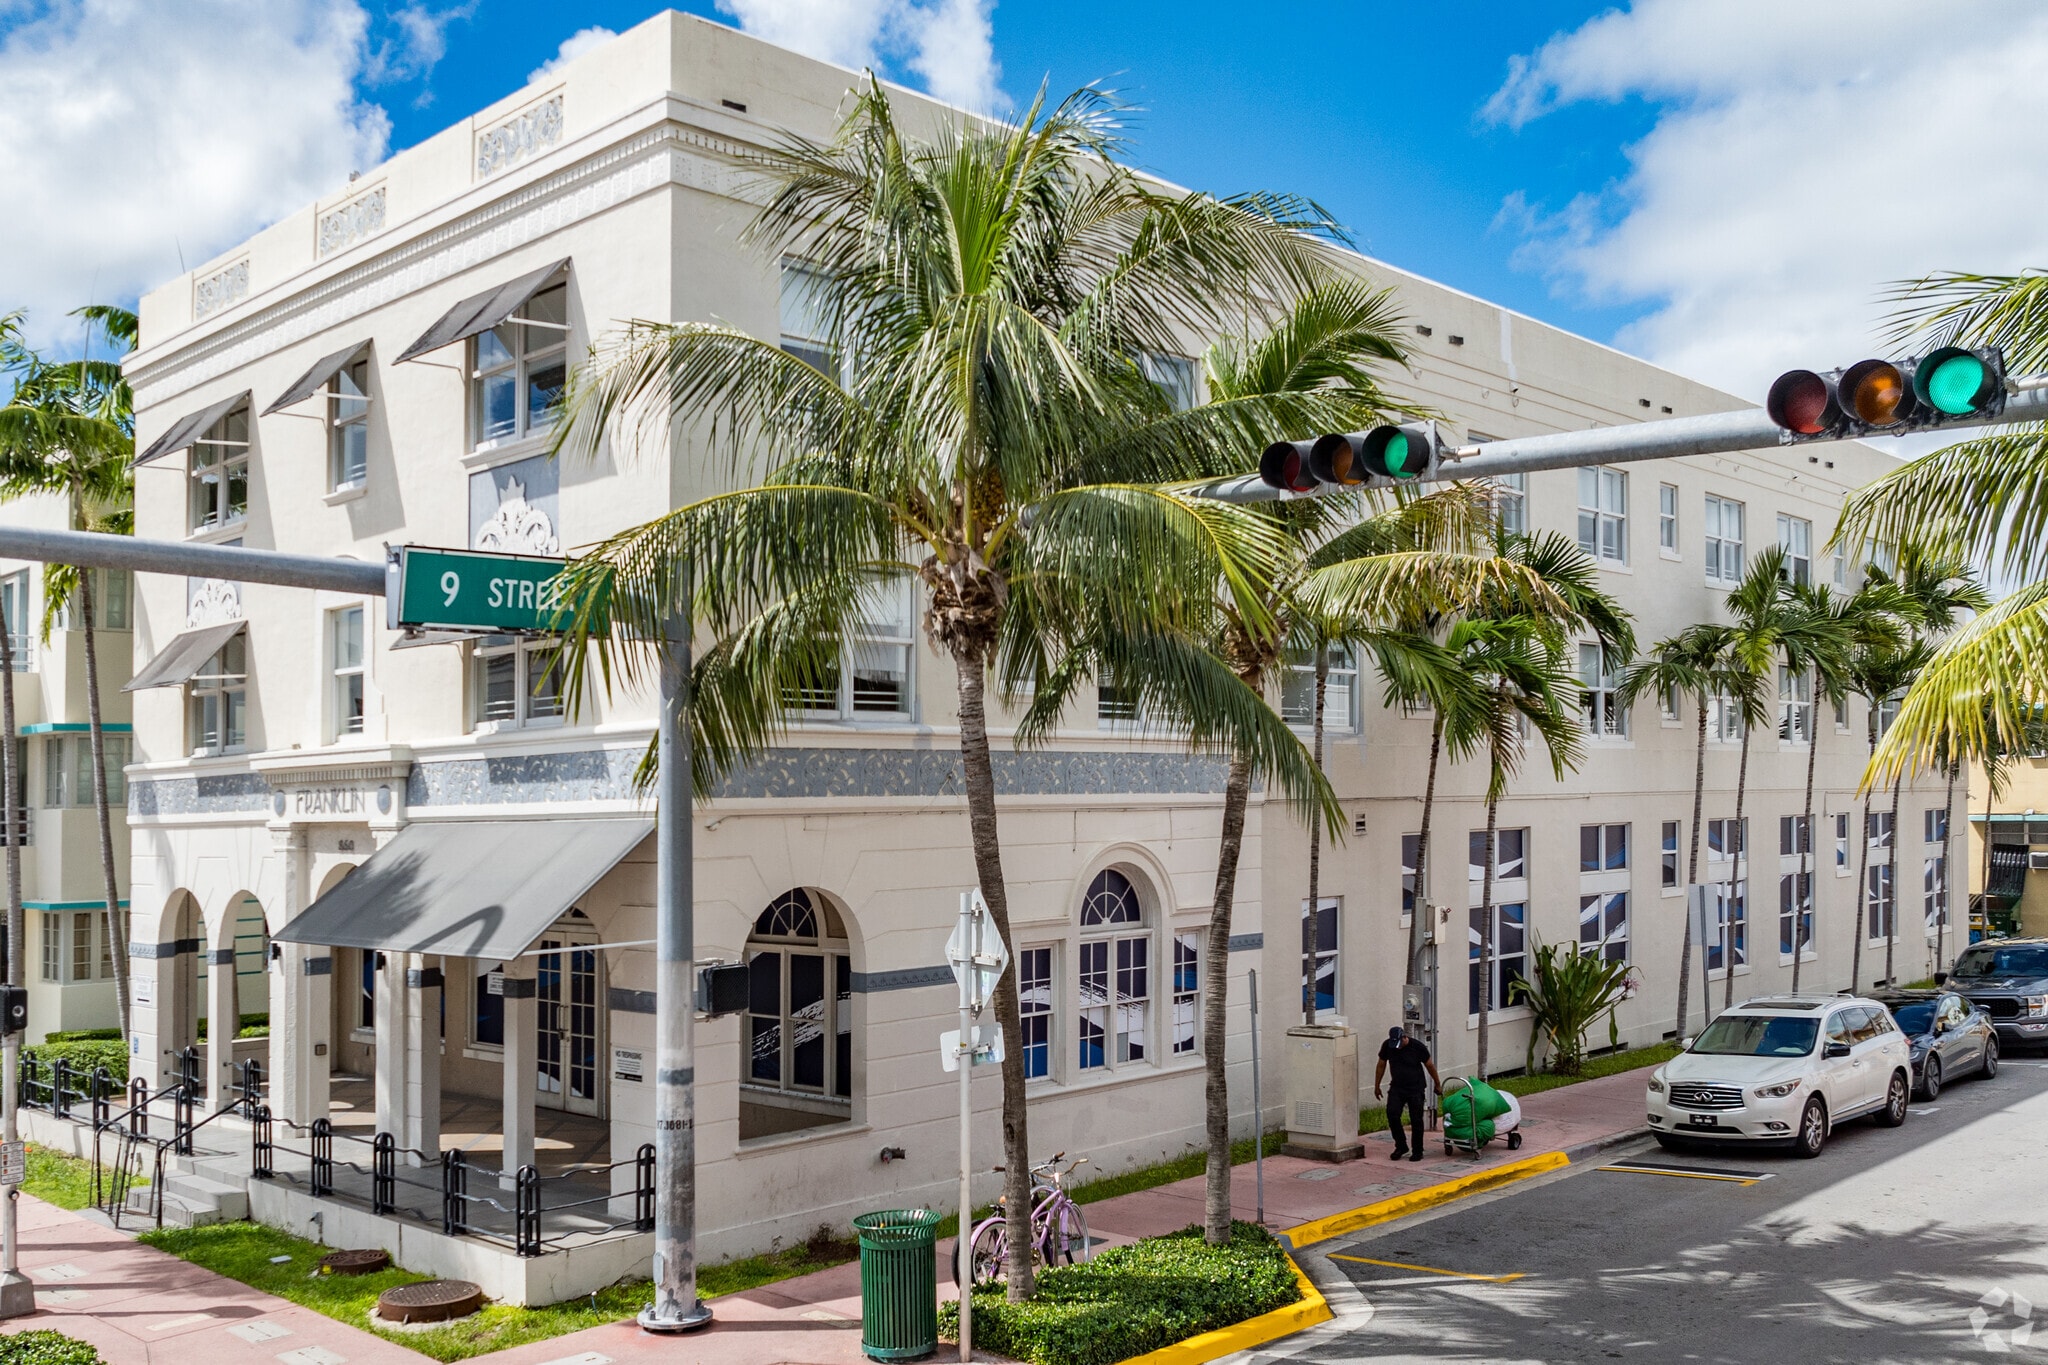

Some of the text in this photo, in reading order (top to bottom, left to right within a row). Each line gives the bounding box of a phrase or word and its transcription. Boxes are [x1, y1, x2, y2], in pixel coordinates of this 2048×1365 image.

[440, 571, 574, 612] 9 STREE
[296, 788, 366, 814] FRANKLIN
